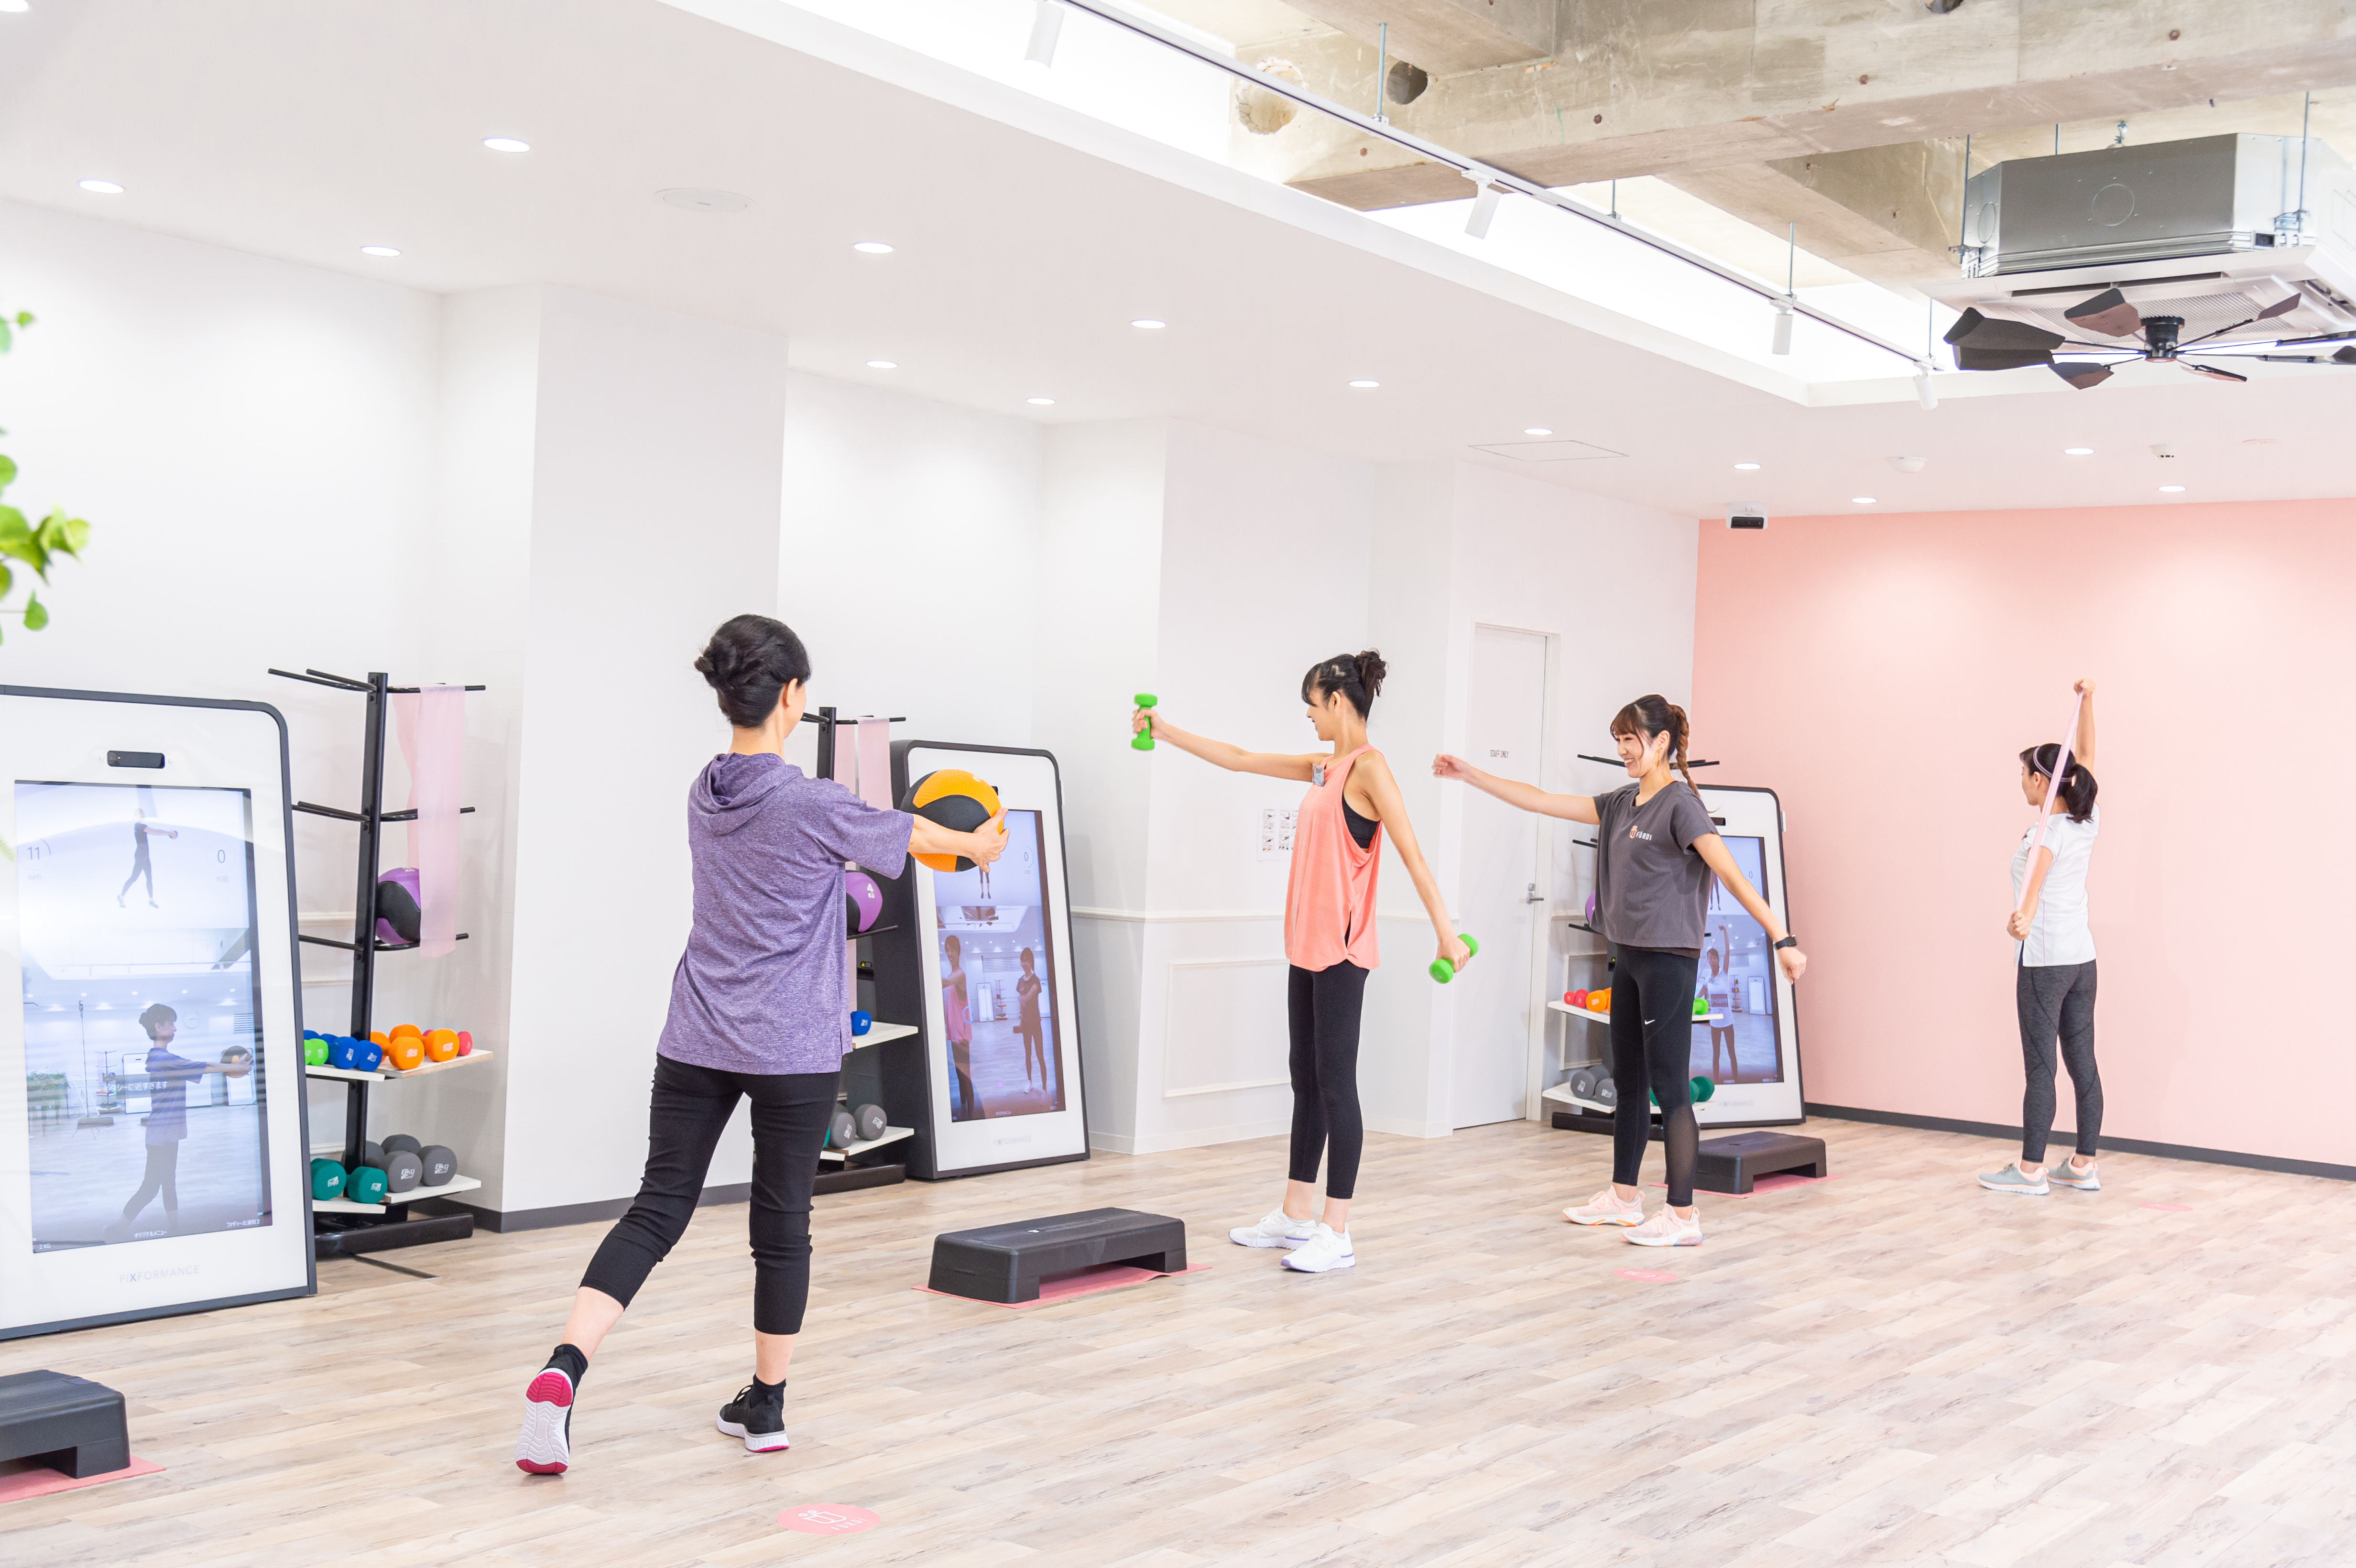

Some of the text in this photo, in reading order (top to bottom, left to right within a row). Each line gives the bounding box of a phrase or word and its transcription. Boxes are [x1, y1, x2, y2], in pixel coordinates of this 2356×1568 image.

[27, 847, 40, 860] 11
[217, 849, 226, 863] 0
[1024, 851, 1029, 861] 0
[1748, 871, 1753, 879] 0
[867, 883, 874, 893] 4
[993, 1135, 1032, 1145] PIXFORMANCE
[120, 1265, 200, 1284] PIXFORMANCE
